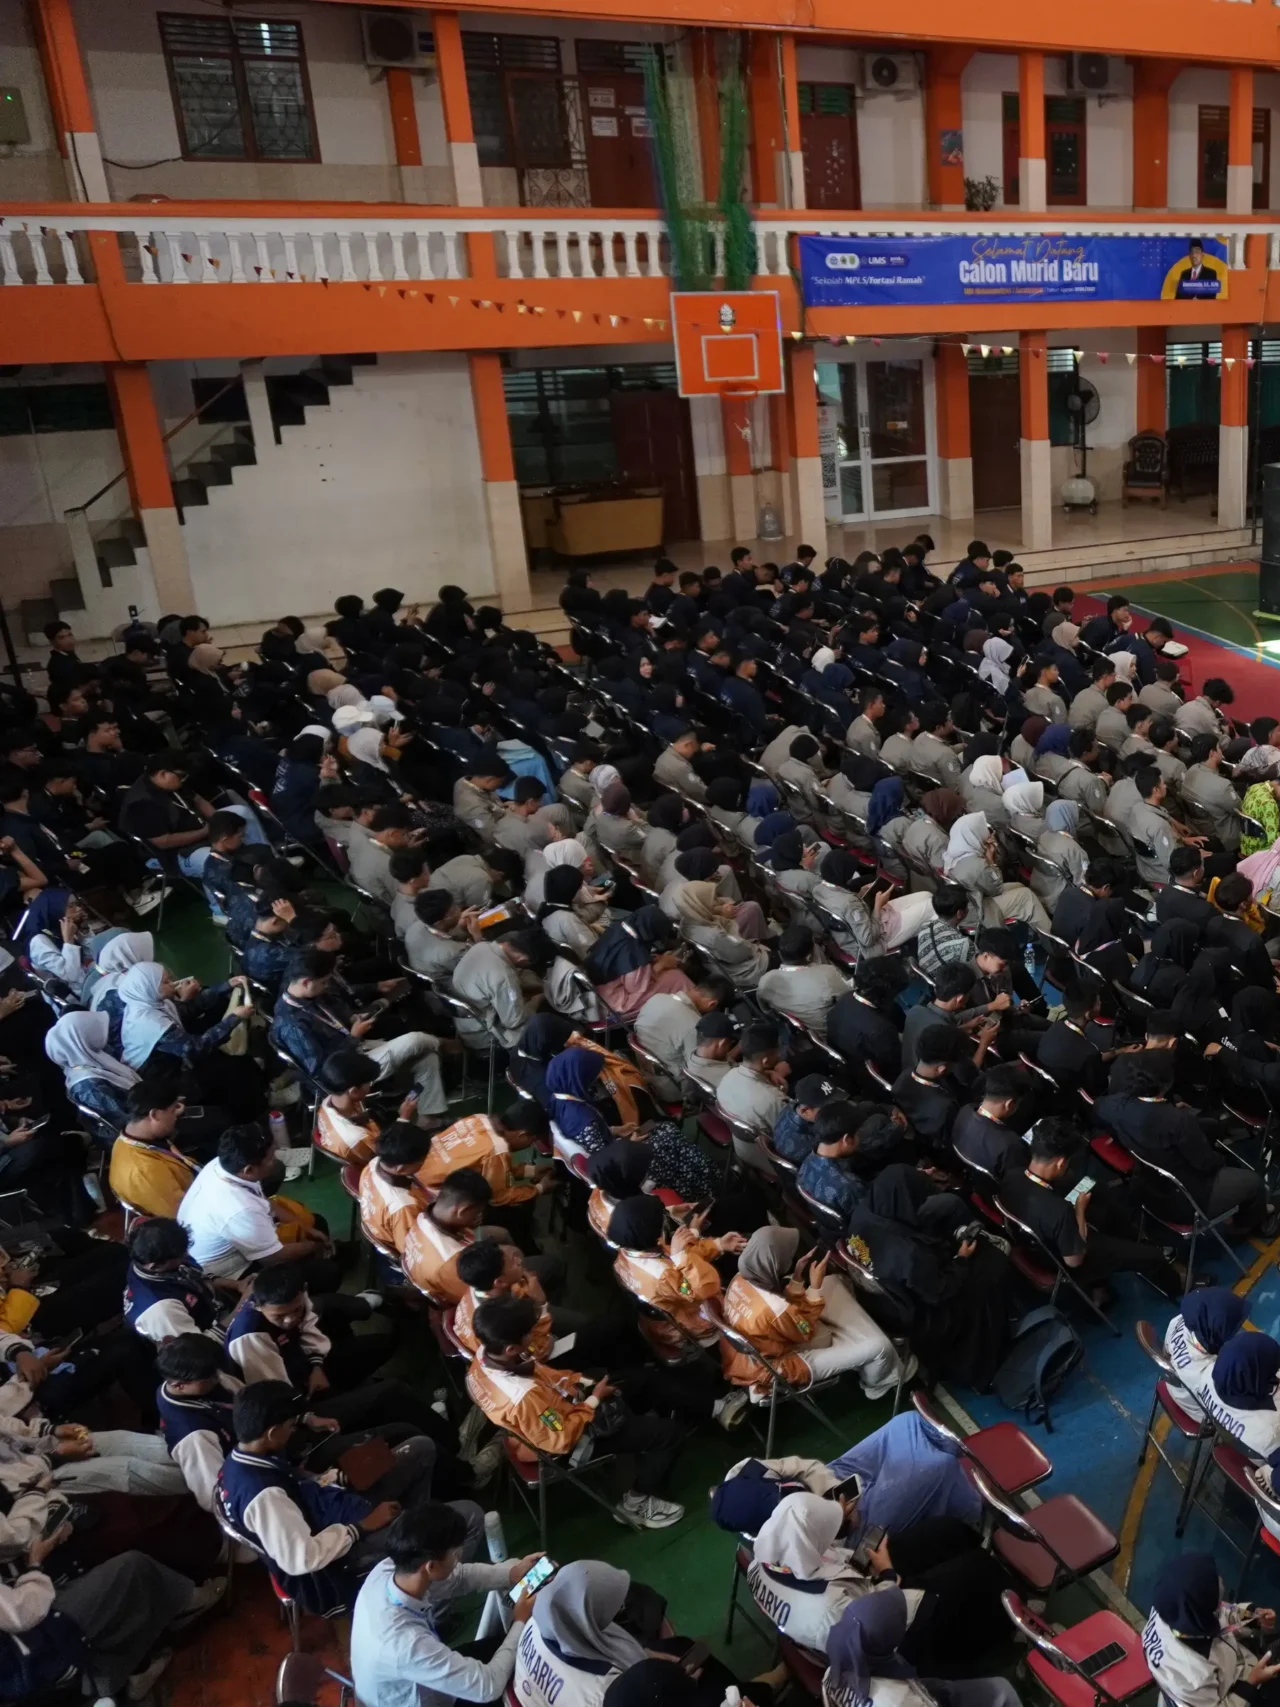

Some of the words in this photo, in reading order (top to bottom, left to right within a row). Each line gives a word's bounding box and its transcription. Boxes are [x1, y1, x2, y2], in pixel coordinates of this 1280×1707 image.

[868, 256, 886, 265] UMS
[972, 238, 1033, 265] Selamat
[959, 260, 1007, 283] Calon
[1011, 259, 1059, 282] Murid
[1063, 259, 1098, 281] Baru
[519, 1624, 565, 1706] MAKARYO
